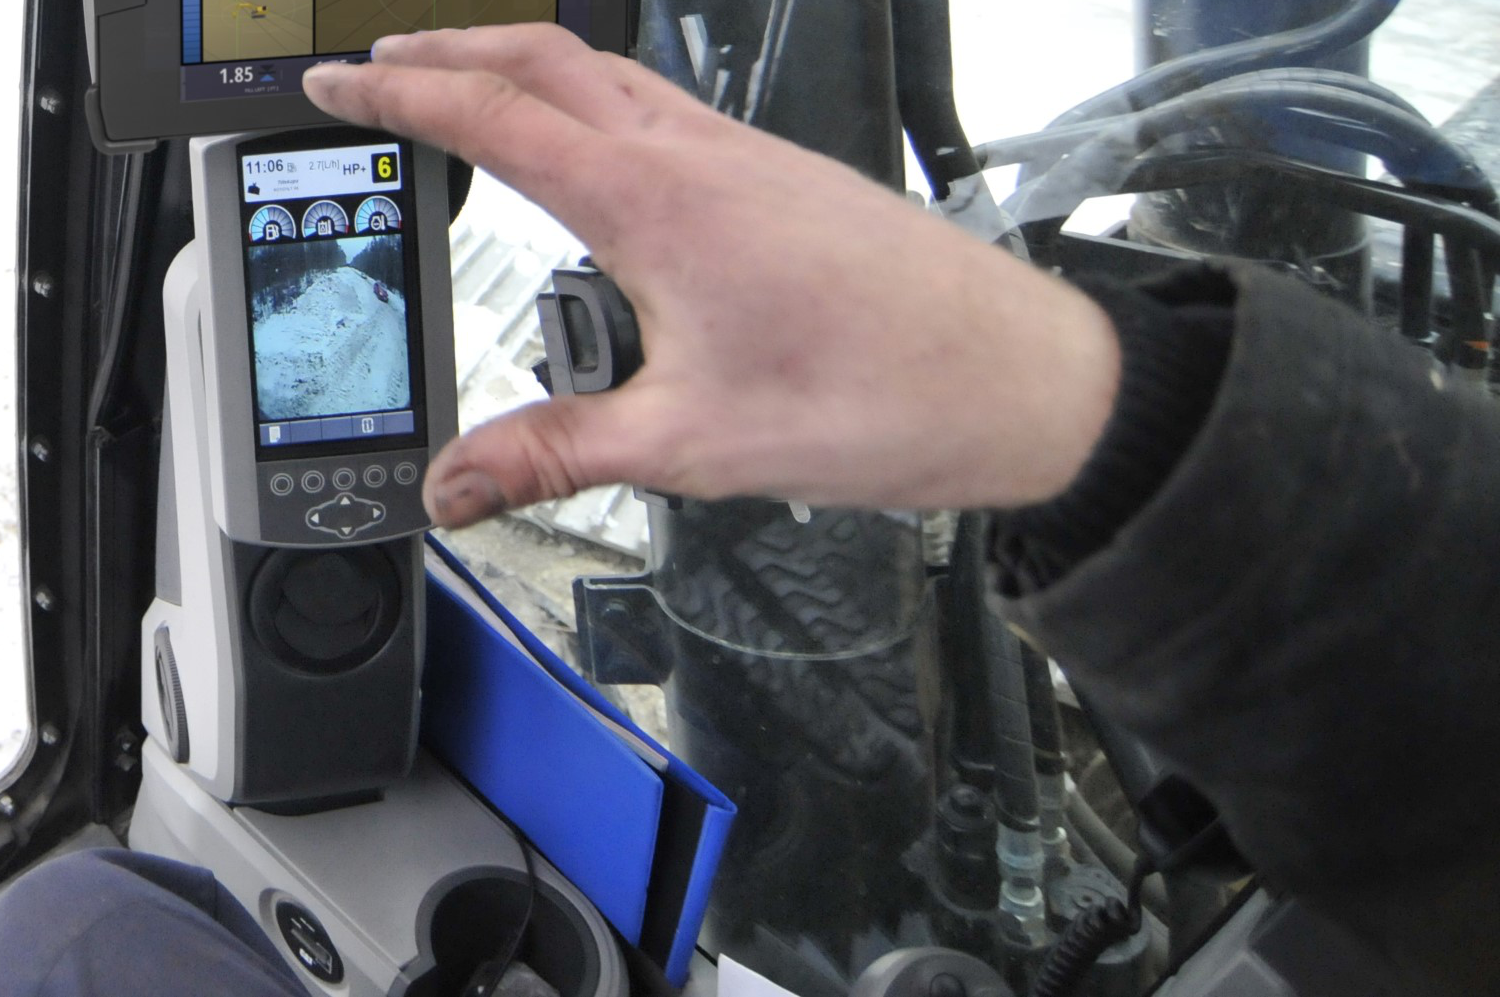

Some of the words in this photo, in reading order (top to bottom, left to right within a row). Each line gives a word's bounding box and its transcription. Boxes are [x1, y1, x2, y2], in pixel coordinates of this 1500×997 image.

[219, 66, 254, 84] 1.85
[246, 159, 284, 174] 11:06
[343, 164, 367, 176] HP+
[377, 156, 392, 178] 6
